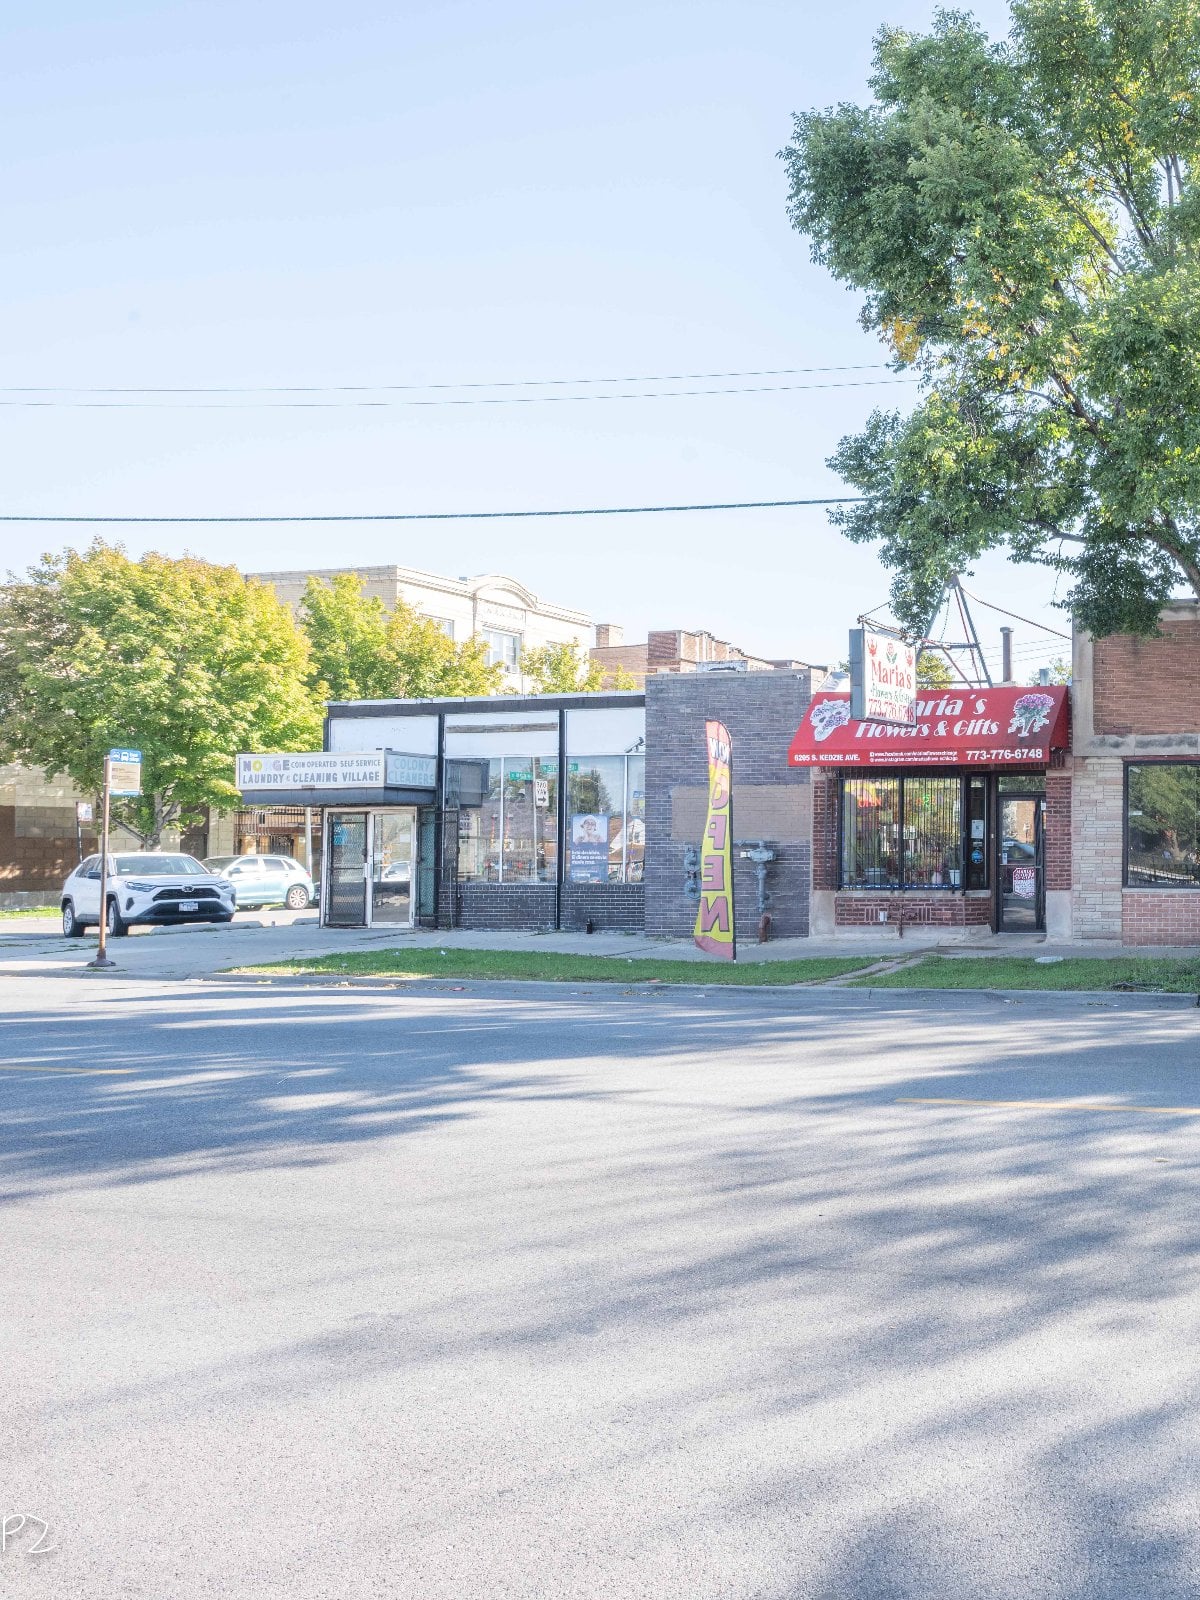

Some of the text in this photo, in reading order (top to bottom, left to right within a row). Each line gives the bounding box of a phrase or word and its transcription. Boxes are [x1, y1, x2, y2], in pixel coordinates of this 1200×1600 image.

[855, 718, 1000, 738] Flowers & Gifts
[966, 748, 1043, 760] 773-776-6748
[306, 760, 338, 768] OPERATED
[340, 760, 354, 768] SELF
[355, 759, 382, 767] SERVICE
[393, 758, 430, 770] COLONY
[243, 773, 285, 784] LAUNDRY
[293, 772, 338, 783] CLEANING
[342, 771, 380, 782] VILLAGE
